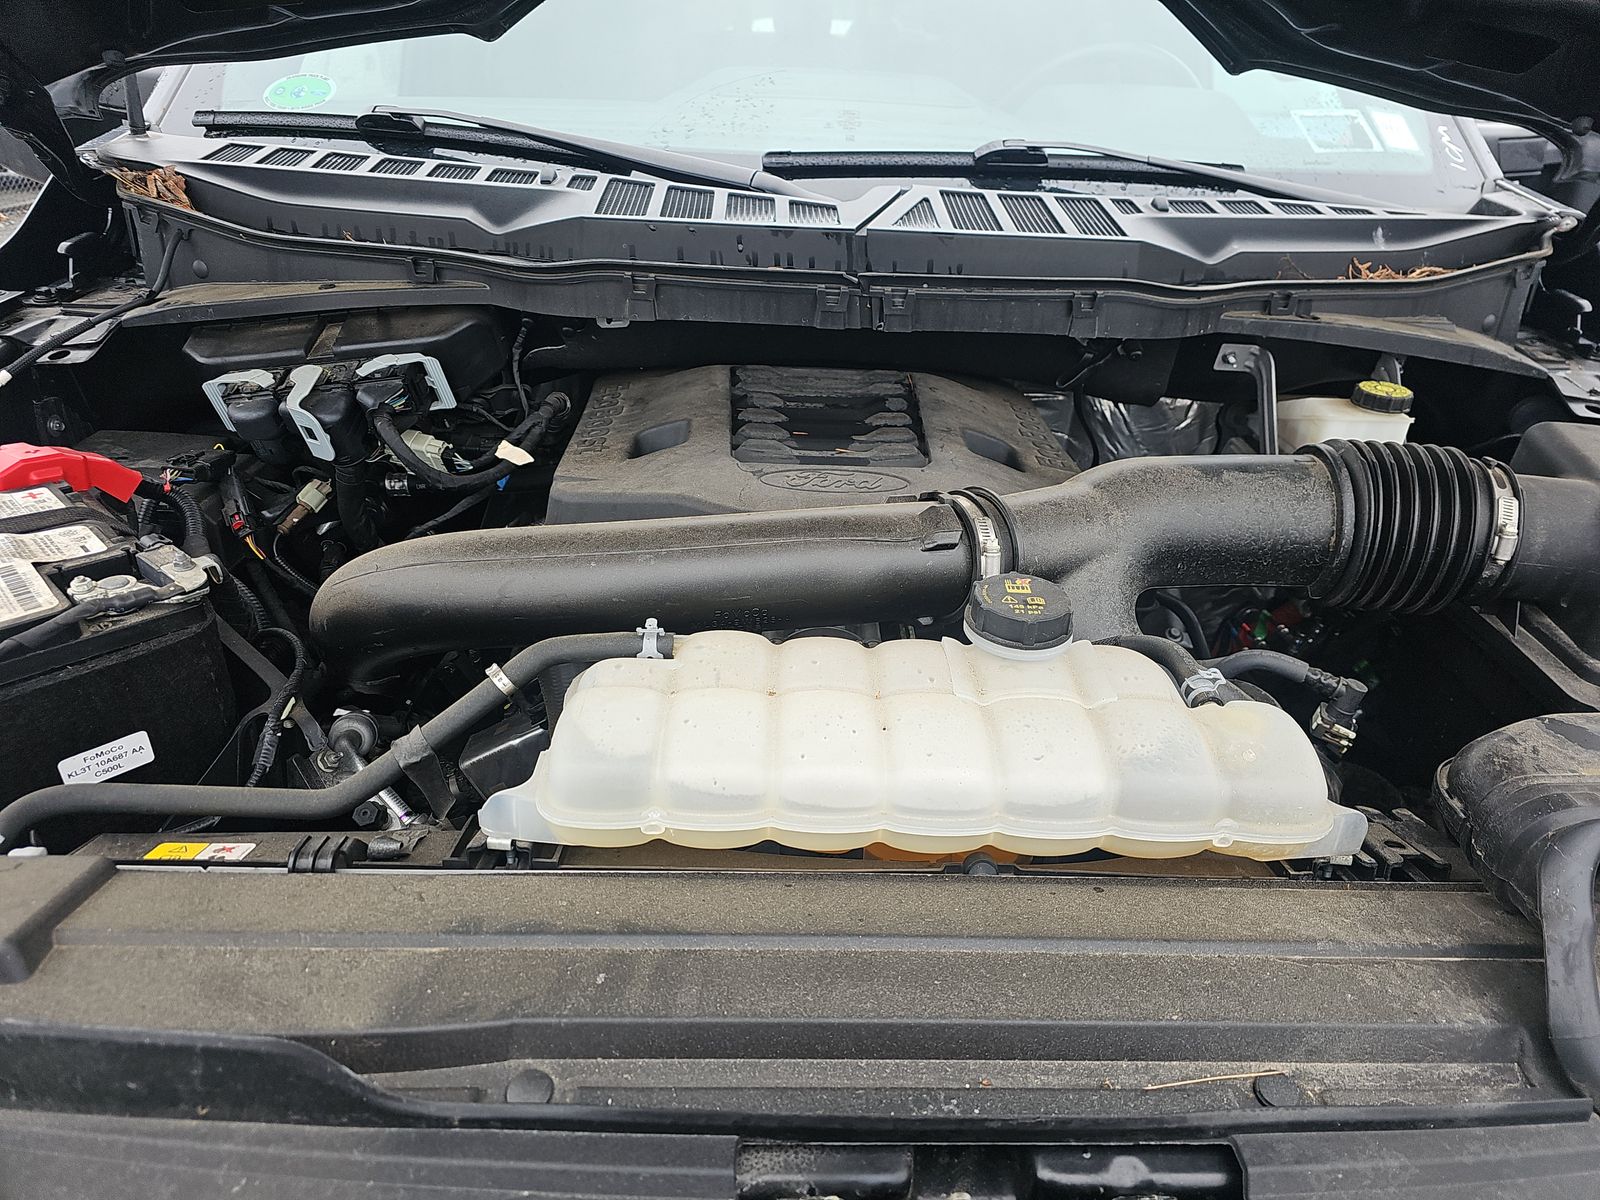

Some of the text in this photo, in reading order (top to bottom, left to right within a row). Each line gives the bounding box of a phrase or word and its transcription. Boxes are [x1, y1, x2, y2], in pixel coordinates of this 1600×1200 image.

[785, 471, 884, 490] Ford
[67, 745, 145, 779] KL3T 10A687 AA
[83, 745, 124, 763] FoMoCo
[94, 763, 124, 778] C500L
